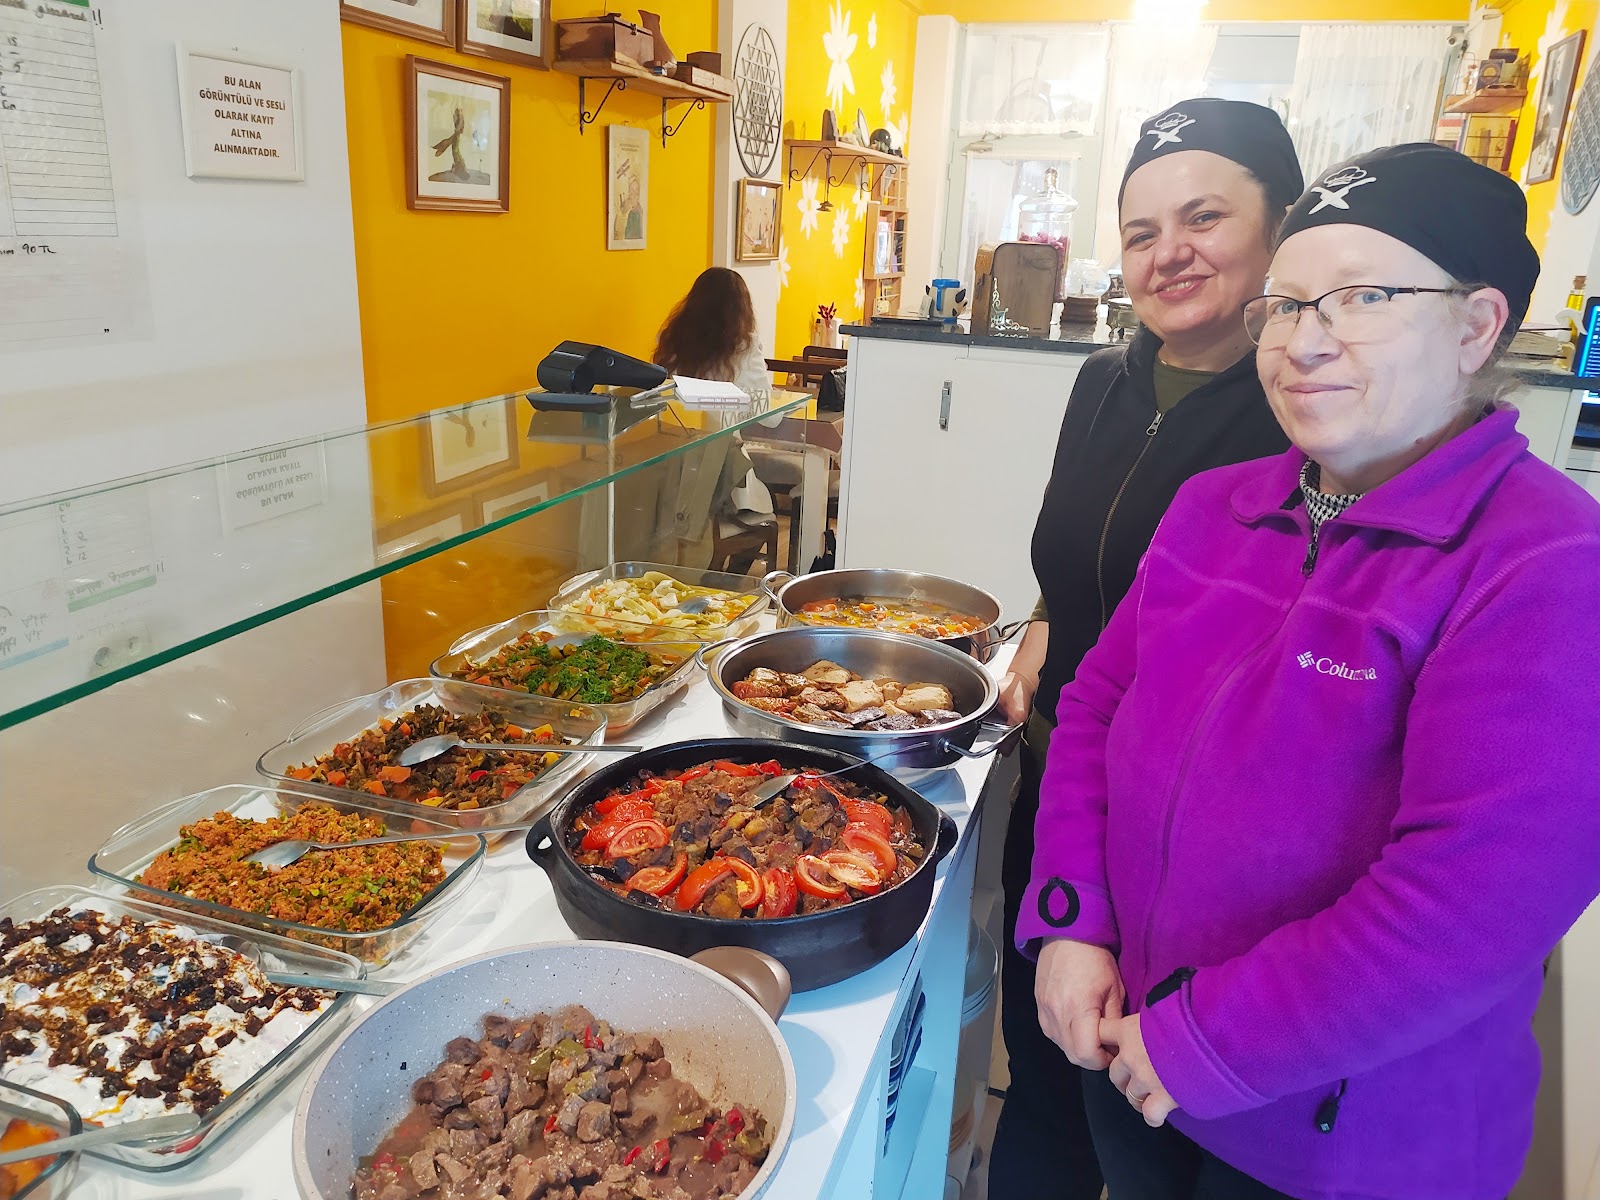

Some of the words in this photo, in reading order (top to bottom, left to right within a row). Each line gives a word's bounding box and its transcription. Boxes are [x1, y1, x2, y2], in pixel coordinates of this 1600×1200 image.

[224, 75, 236, 86] BU
[238, 78, 262, 90] ALAN
[199, 88, 252, 106] GÖRÜNTÜLÜ
[254, 97, 265, 107] VE
[266, 100, 286, 110] SESLİ
[214, 109, 249, 122] OLARAK
[250, 113, 275, 125] KAYIT
[230, 128, 262, 140] ALTINA
[213, 143, 280, 158] ALINMAKTADIR.
[22, 243, 37, 254] 90
